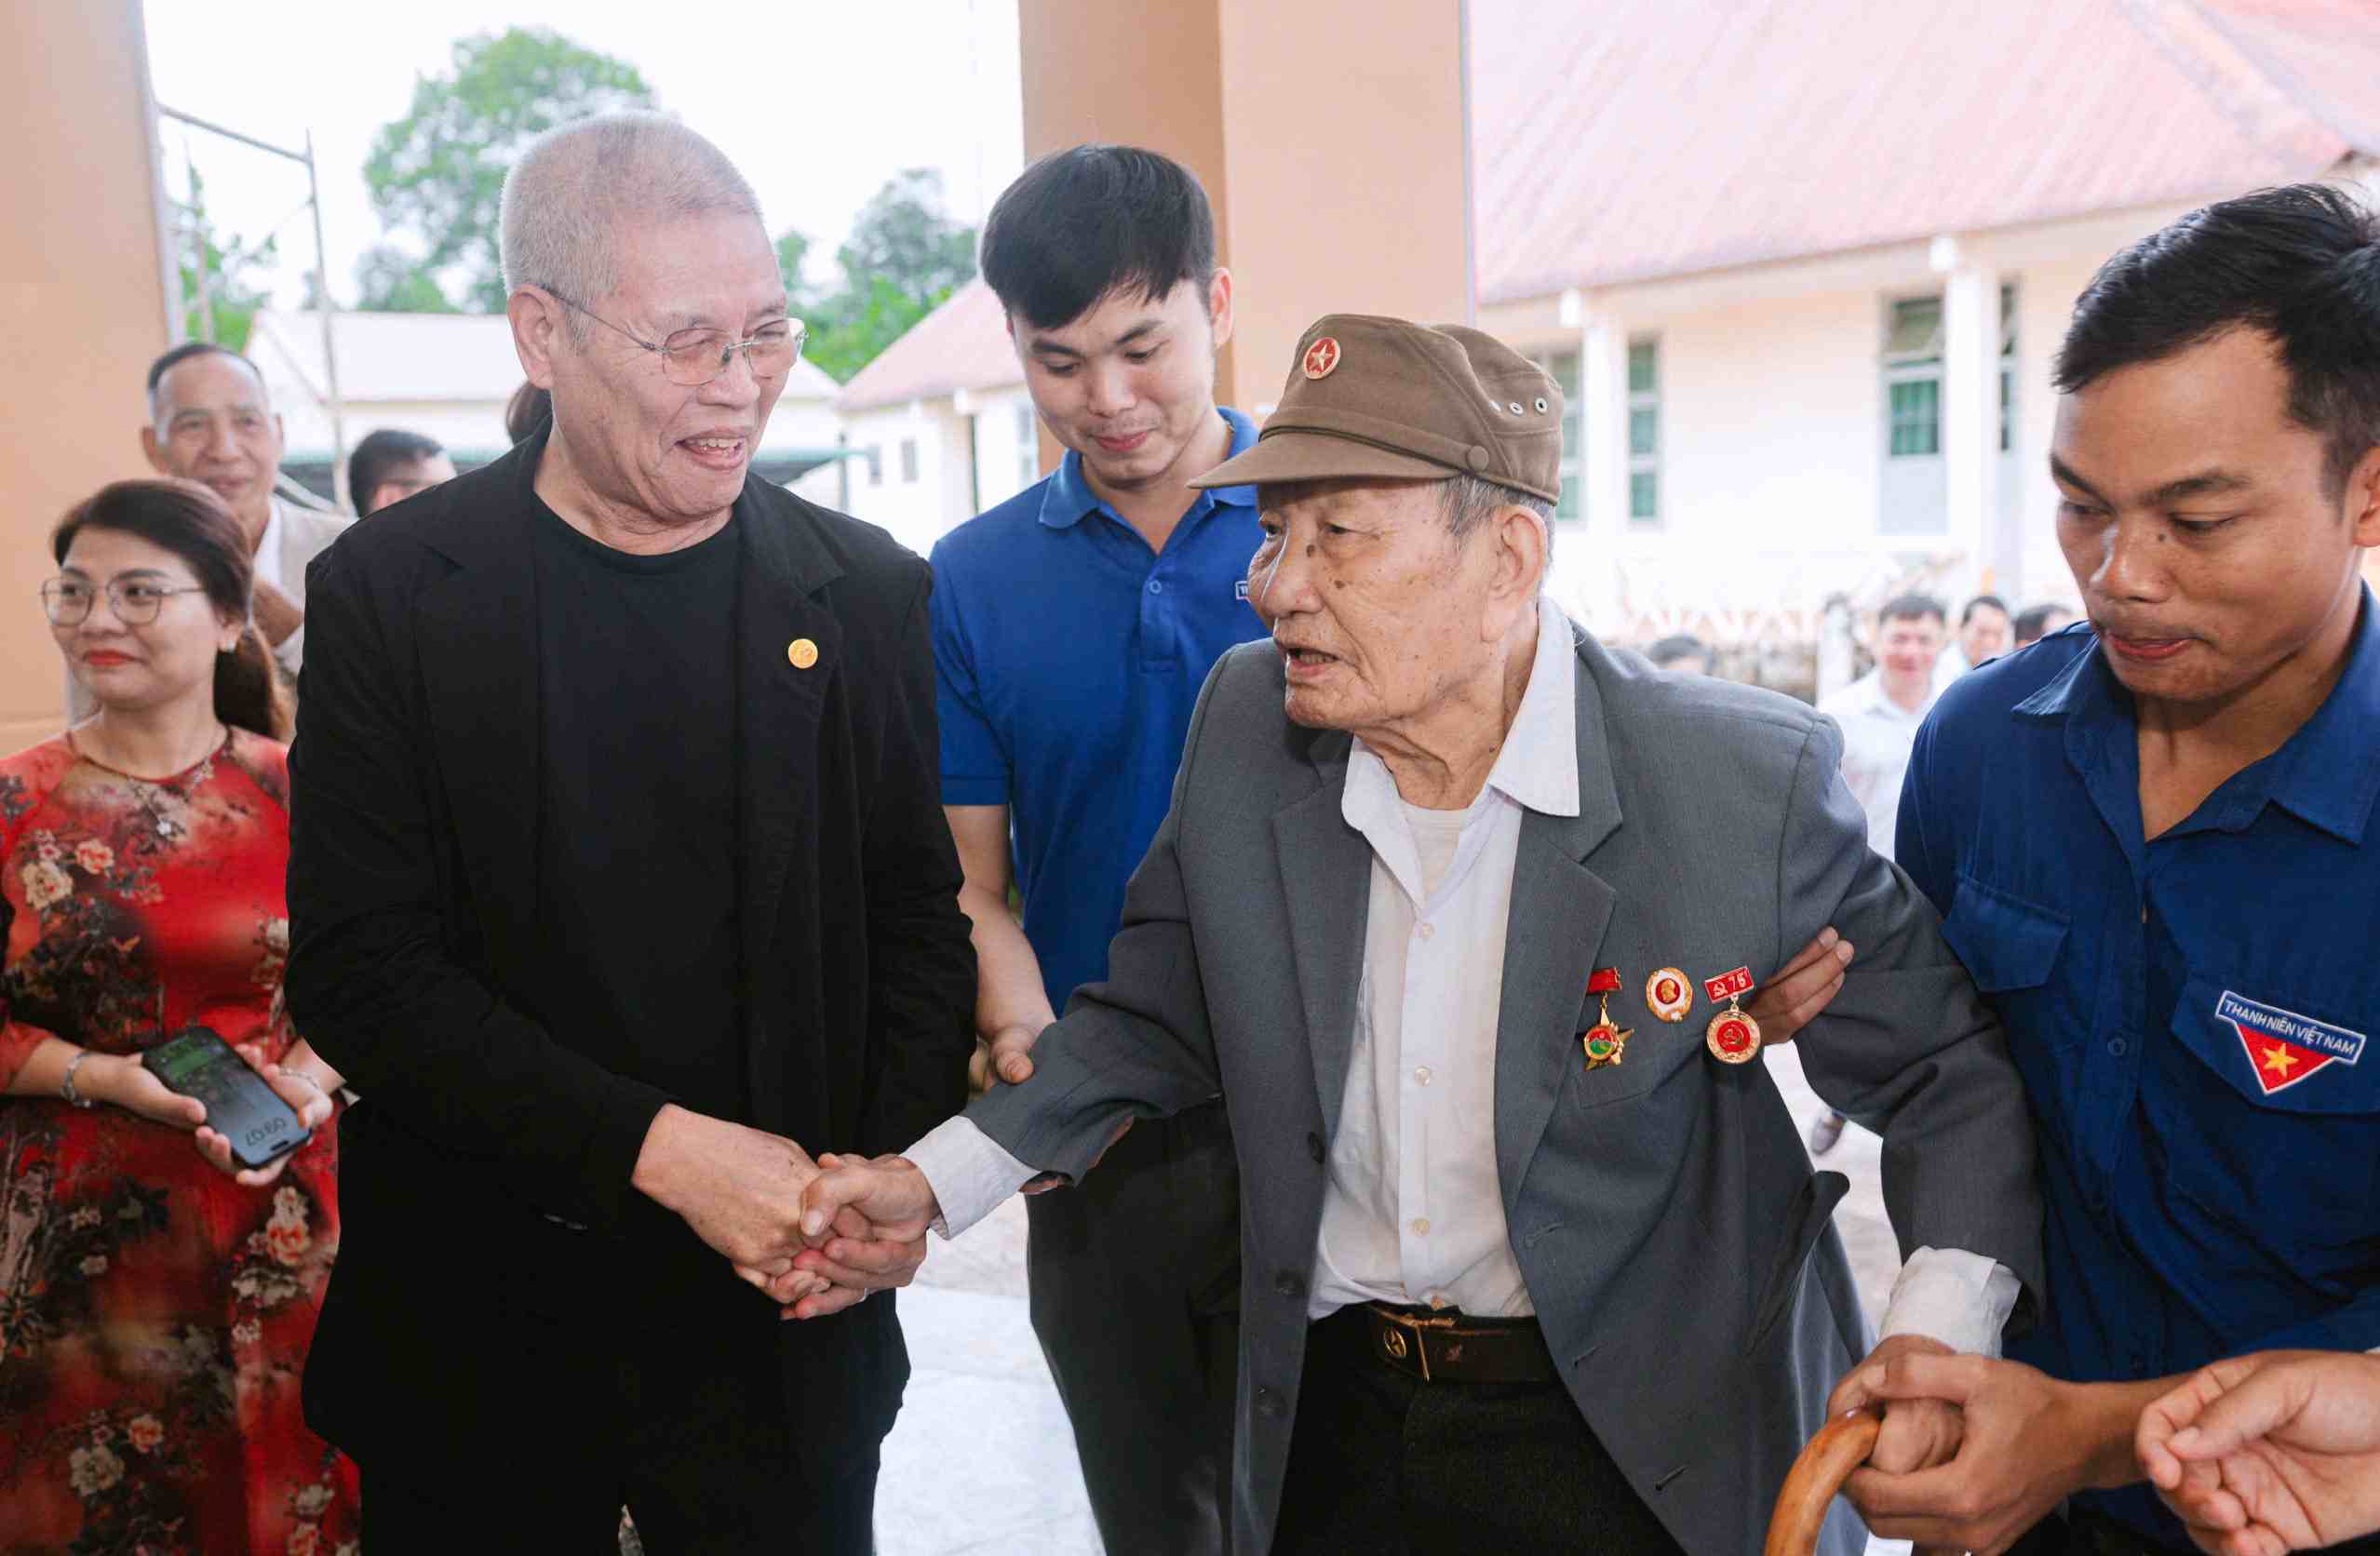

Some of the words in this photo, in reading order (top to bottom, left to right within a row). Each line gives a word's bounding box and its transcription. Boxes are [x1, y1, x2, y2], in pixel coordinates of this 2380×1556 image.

[2225, 1000, 2266, 1026] THANH
[2266, 1015, 2295, 1036] NIÊN
[2296, 1026, 2324, 1045] VIỆT
[2322, 1036, 2356, 1054] NAM
